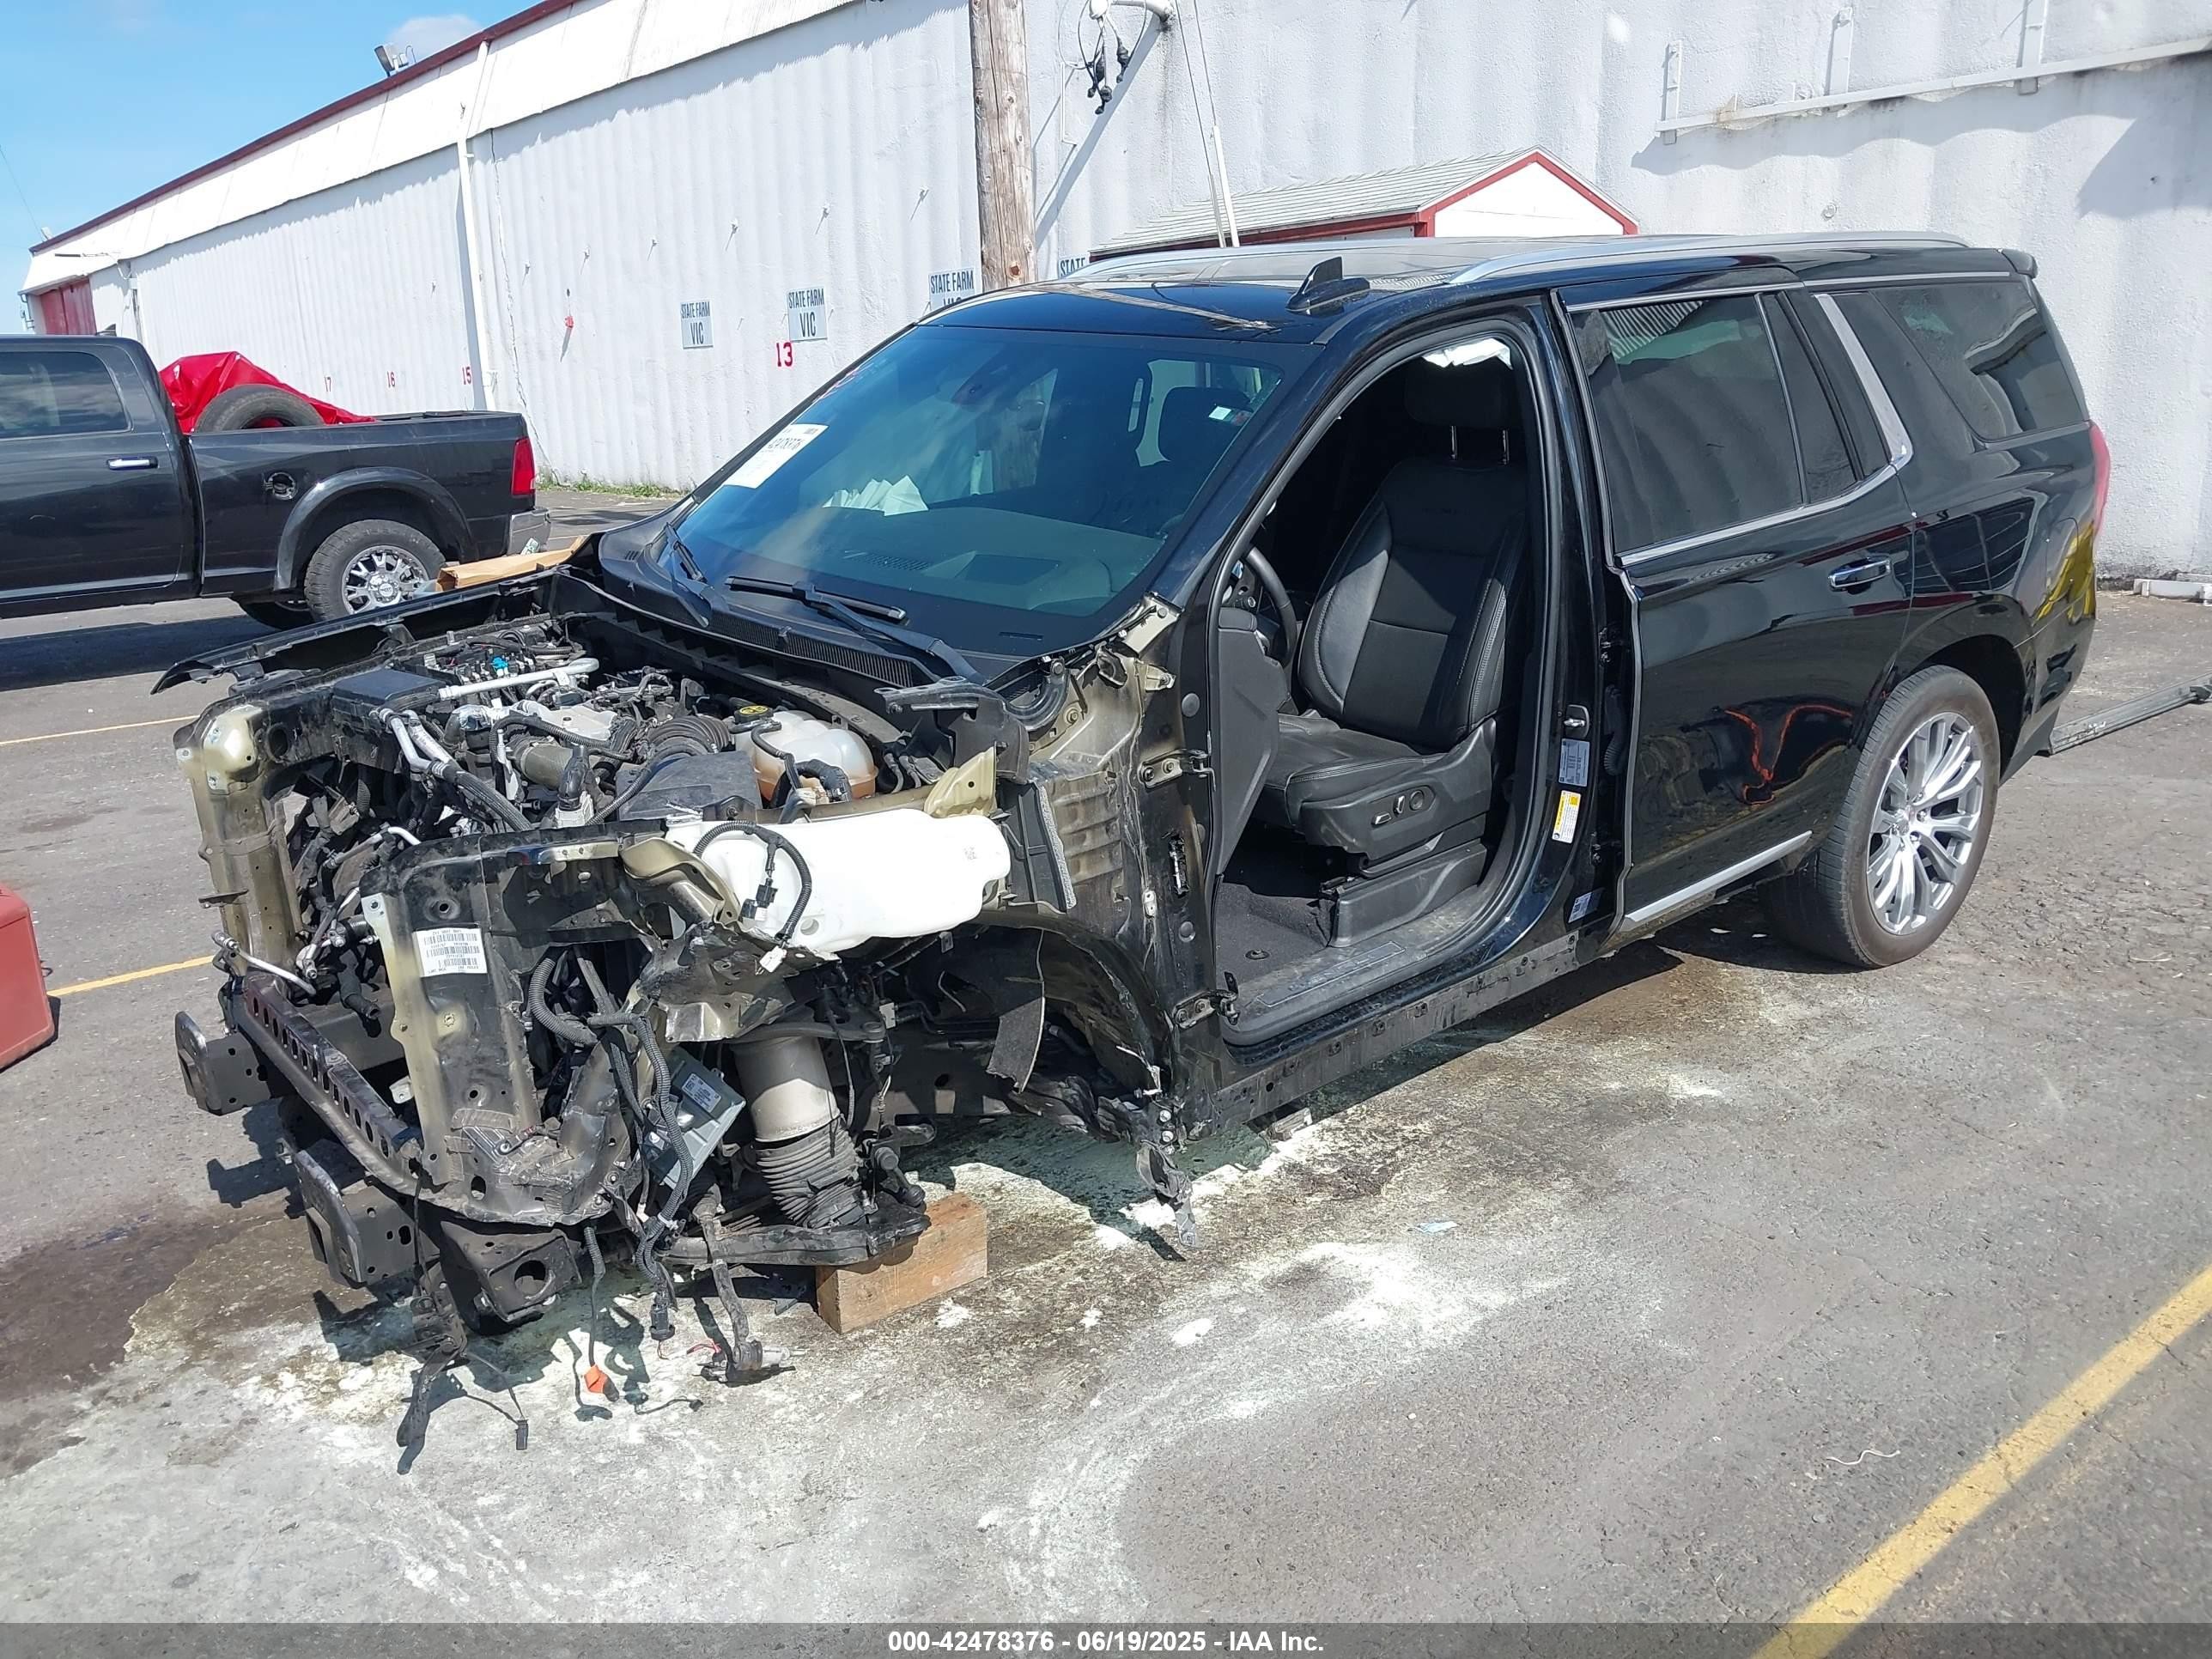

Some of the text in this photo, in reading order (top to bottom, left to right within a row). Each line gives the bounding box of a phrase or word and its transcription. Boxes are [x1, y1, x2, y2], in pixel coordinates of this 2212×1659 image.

[930, 270, 974, 294] STATE FARM
[788, 288, 824, 308] STATE FARM
[681, 301, 710, 319] STATE FARM
[690, 321, 704, 345] VIC
[799, 311, 817, 337] VIC
[776, 342, 793, 367] 13
[323, 375, 332, 392] 17
[461, 366, 472, 386] 15
